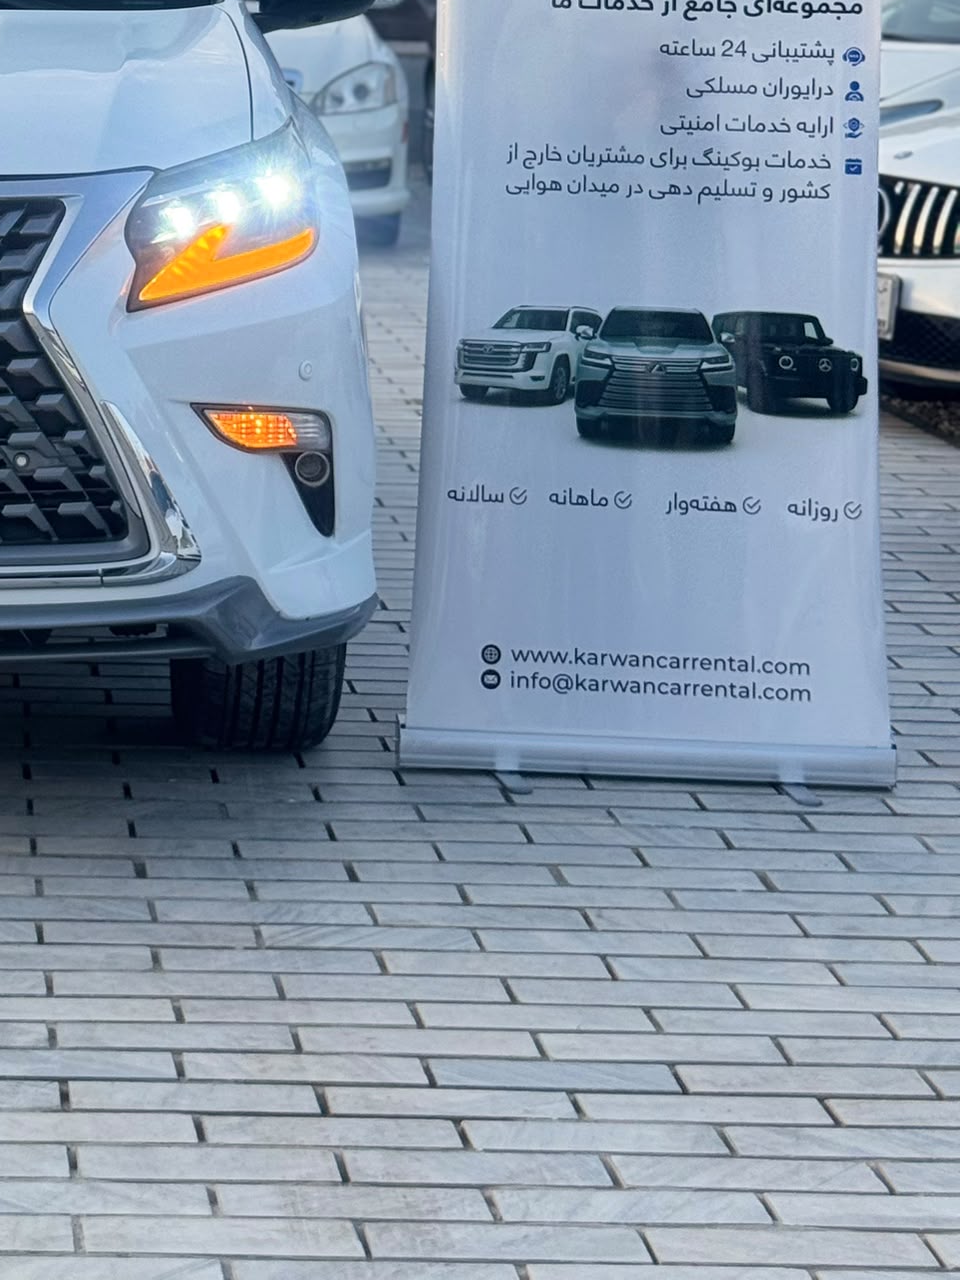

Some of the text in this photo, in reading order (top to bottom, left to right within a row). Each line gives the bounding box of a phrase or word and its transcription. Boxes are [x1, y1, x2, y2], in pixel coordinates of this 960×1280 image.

[659, 38, 835, 67] پشتیبانی 24 ساعته
[685, 75, 834, 101] درایوران مسلکی
[659, 113, 834, 137] ارایه خدمات امنیتی
[506, 141, 832, 173] خدمات بوکینگ برای مشتریان خارج از
[505, 172, 832, 206] کشور و تسلیم دهی در میدان هوایی
[446, 483, 505, 504] سالانه
[548, 487, 609, 508] ماهانه
[786, 497, 839, 523] روزانه
[510, 647, 811, 677] www.karwancarrental.com
[510, 671, 812, 703] info@karwancarrental.com
